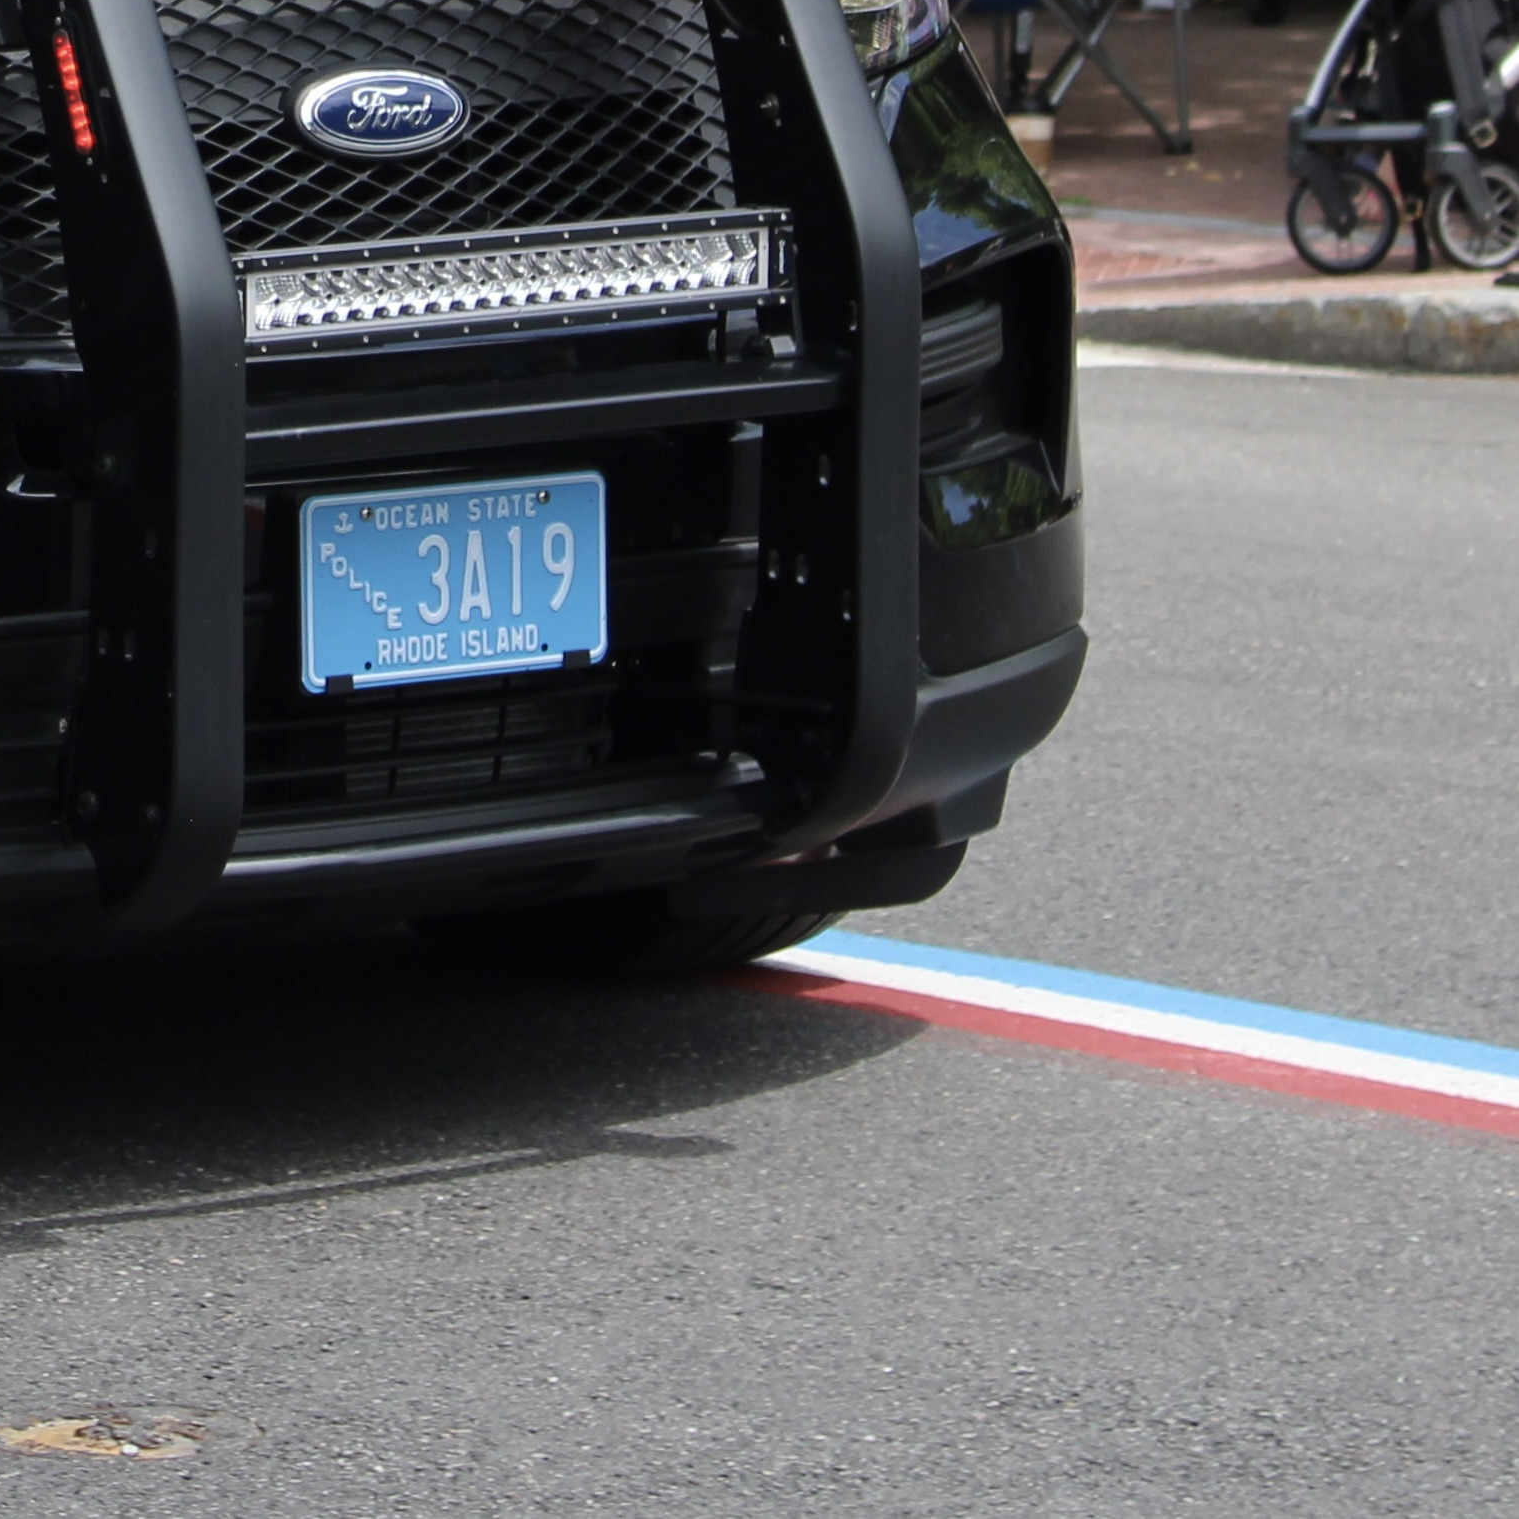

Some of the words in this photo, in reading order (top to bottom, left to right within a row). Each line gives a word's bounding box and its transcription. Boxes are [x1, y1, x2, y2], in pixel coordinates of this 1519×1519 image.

[347, 85, 433, 131] Ford
[375, 502, 450, 532] OCEAN
[468, 492, 538, 522] STATE
[319, 542, 403, 630] POLICE
[417, 520, 576, 626] 3A19
[377, 632, 449, 666] RHODE
[461, 624, 540, 658] ISLAND
